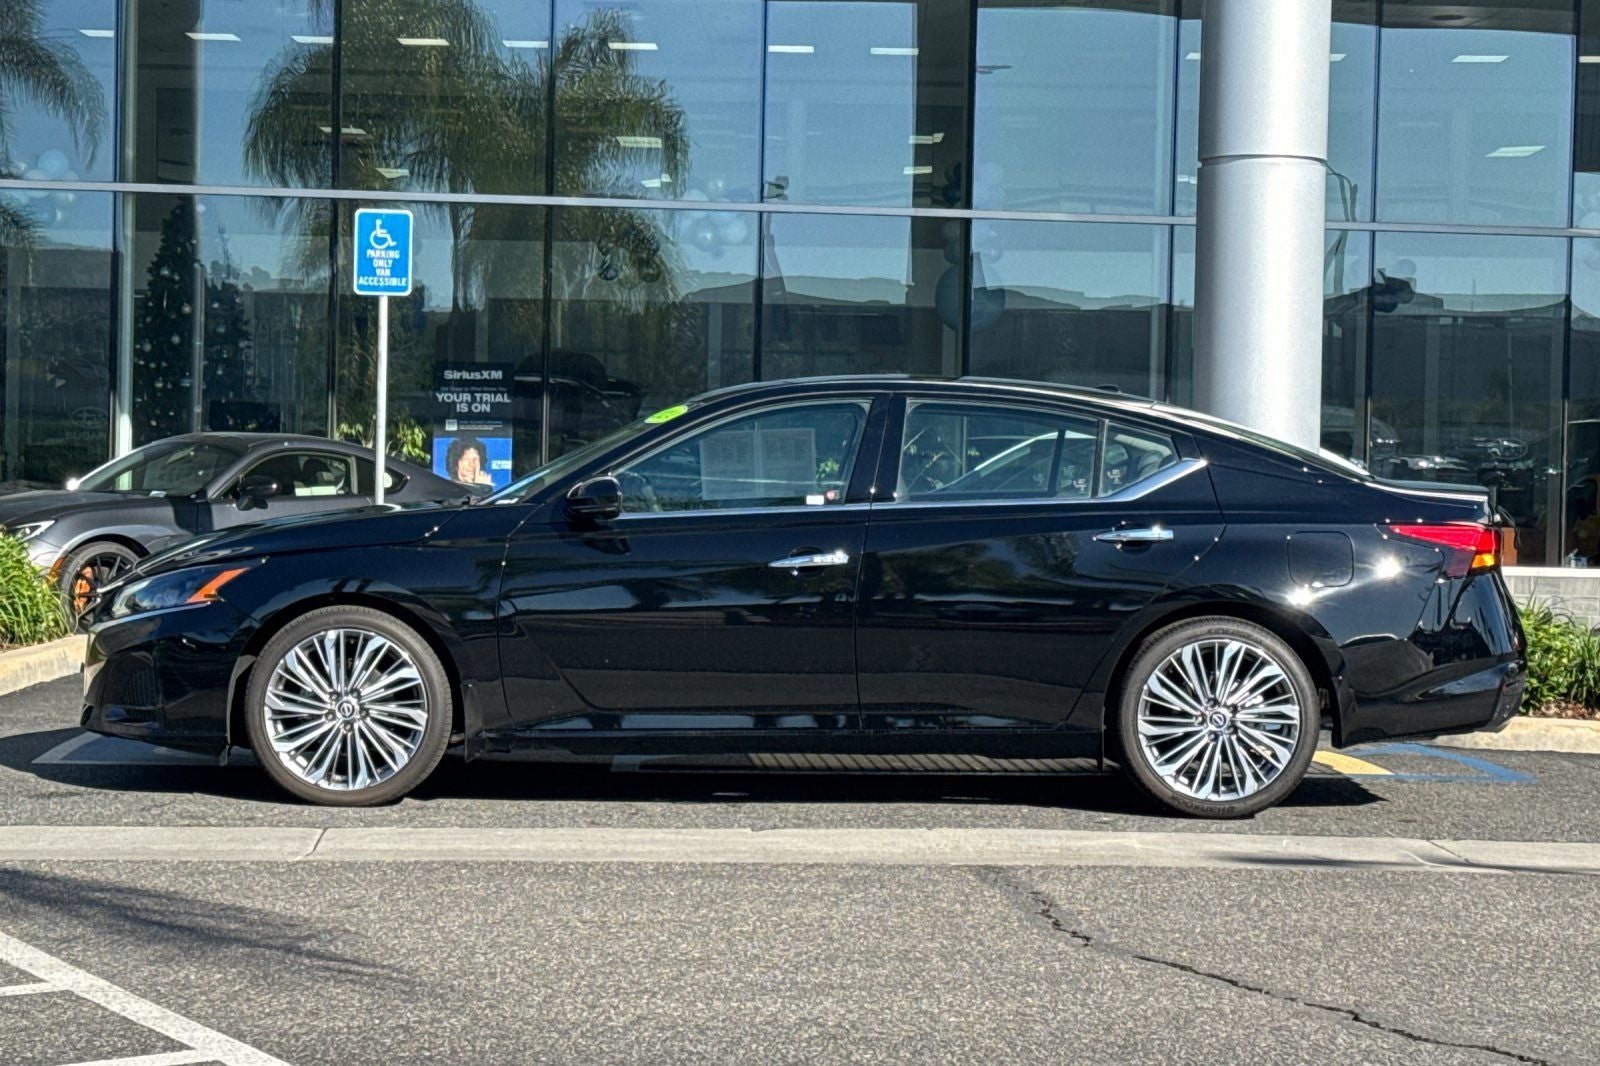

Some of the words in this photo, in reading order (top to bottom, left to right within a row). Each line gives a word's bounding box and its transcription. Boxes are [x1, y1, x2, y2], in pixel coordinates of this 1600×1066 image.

[366, 249, 400, 259] PARKING
[373, 258, 394, 268] ONLY
[376, 268, 391, 277] VAN
[358, 276, 407, 287] ACCESSIBLE
[444, 370, 503, 380] SiriusXM
[435, 393, 472, 403] YOUR
[474, 393, 512, 403] TRIAL
[456, 403, 469, 413] IS
[471, 403, 491, 413] ON
